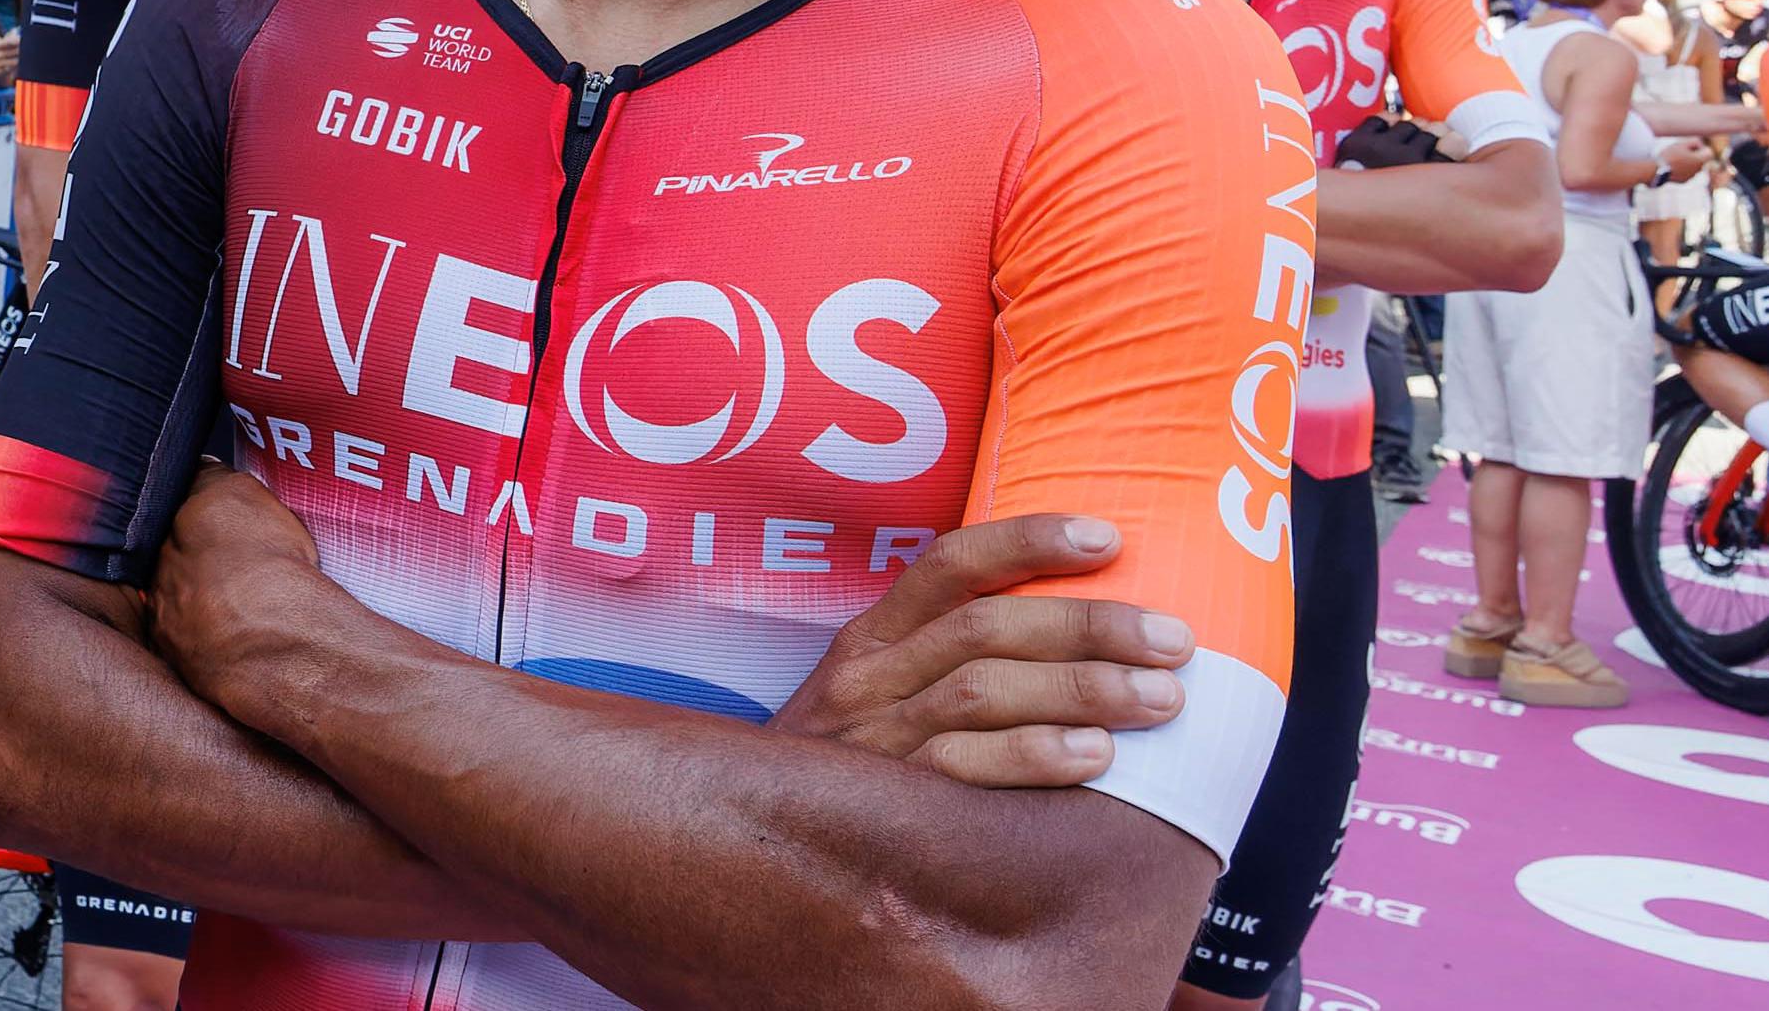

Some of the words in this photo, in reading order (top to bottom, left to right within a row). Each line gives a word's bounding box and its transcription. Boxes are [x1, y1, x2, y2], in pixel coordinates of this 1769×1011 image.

[428, 37, 492, 63] WORLD
[433, 23, 472, 42] UCI
[422, 52, 471, 75] TEAM
[316, 88, 483, 175] GOBIK
[653, 153, 913, 197] PINARELLO
[1218, 77, 1319, 564] INEOS
[224, 207, 948, 485] INEOS
[233, 402, 938, 576] GRENADIER
[75, 894, 198, 925] GRENADIE
